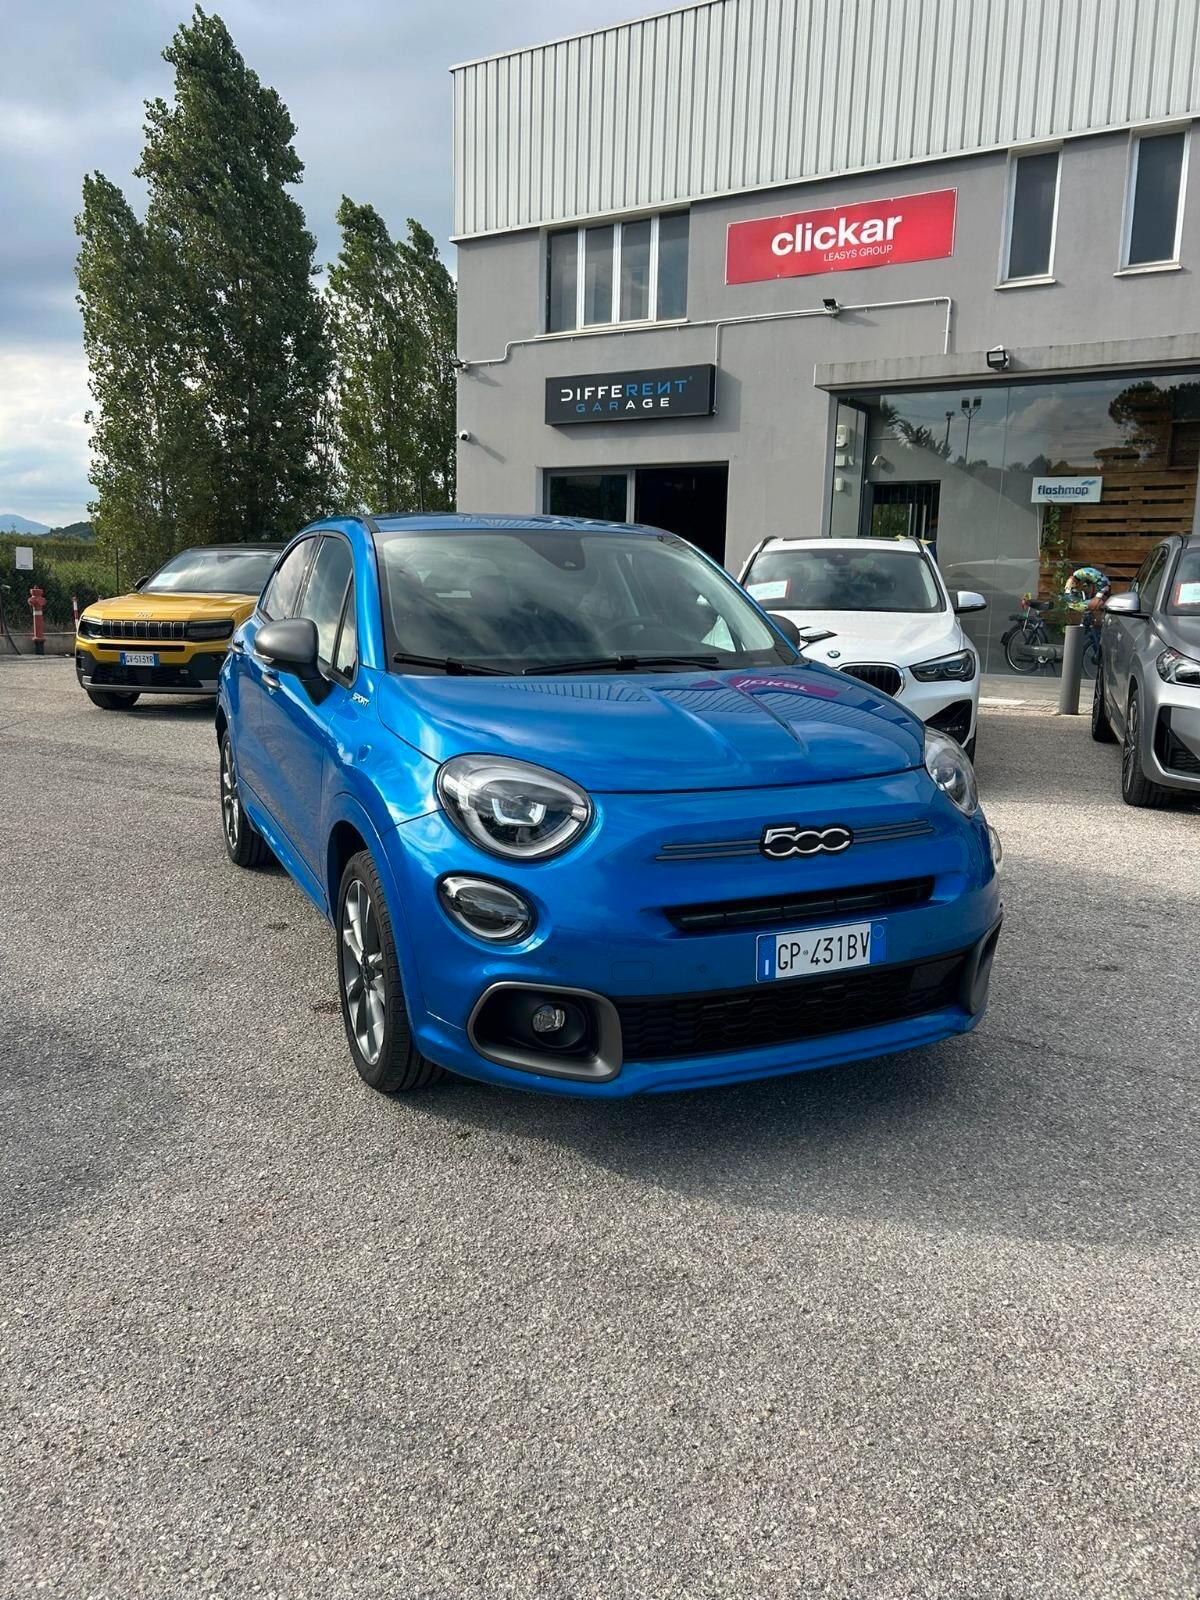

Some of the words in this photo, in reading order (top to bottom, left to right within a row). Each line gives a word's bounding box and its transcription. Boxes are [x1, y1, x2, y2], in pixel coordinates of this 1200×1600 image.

[771, 215, 903, 256] clickar
[823, 249, 858, 262] LEASYS
[859, 244, 893, 257] GROUP
[560, 380, 687, 402] DIFFERENT
[575, 397, 670, 413] GARAGE
[352, 692, 370, 708] SPORT
[764, 826, 851, 857] 500
